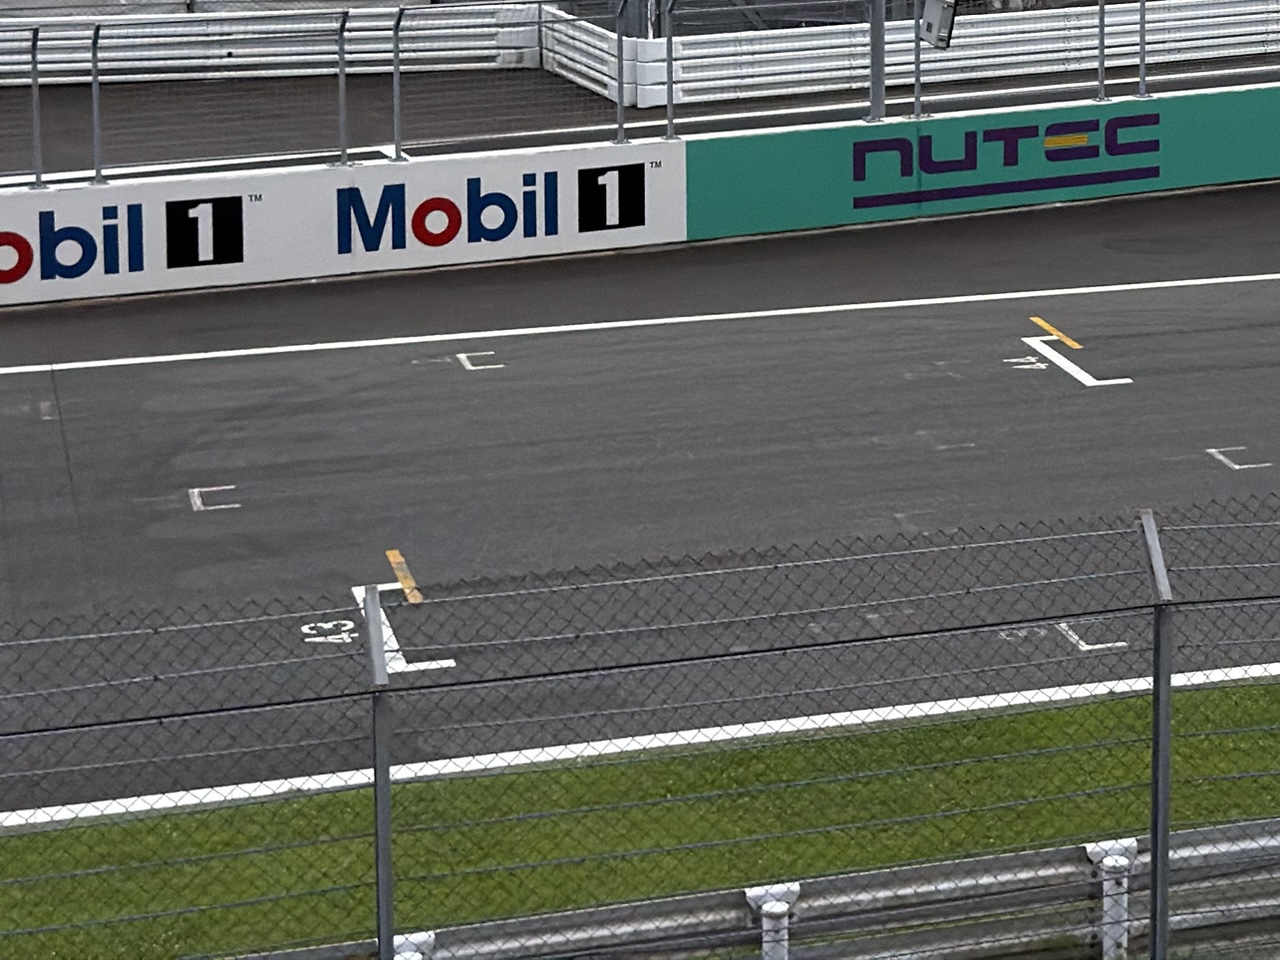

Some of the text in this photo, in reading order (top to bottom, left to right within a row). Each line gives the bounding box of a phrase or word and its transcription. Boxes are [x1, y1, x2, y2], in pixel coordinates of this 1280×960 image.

[0, 203, 144, 284] obil
[336, 171, 558, 255] Mobil
[300, 620, 360, 643] 43
